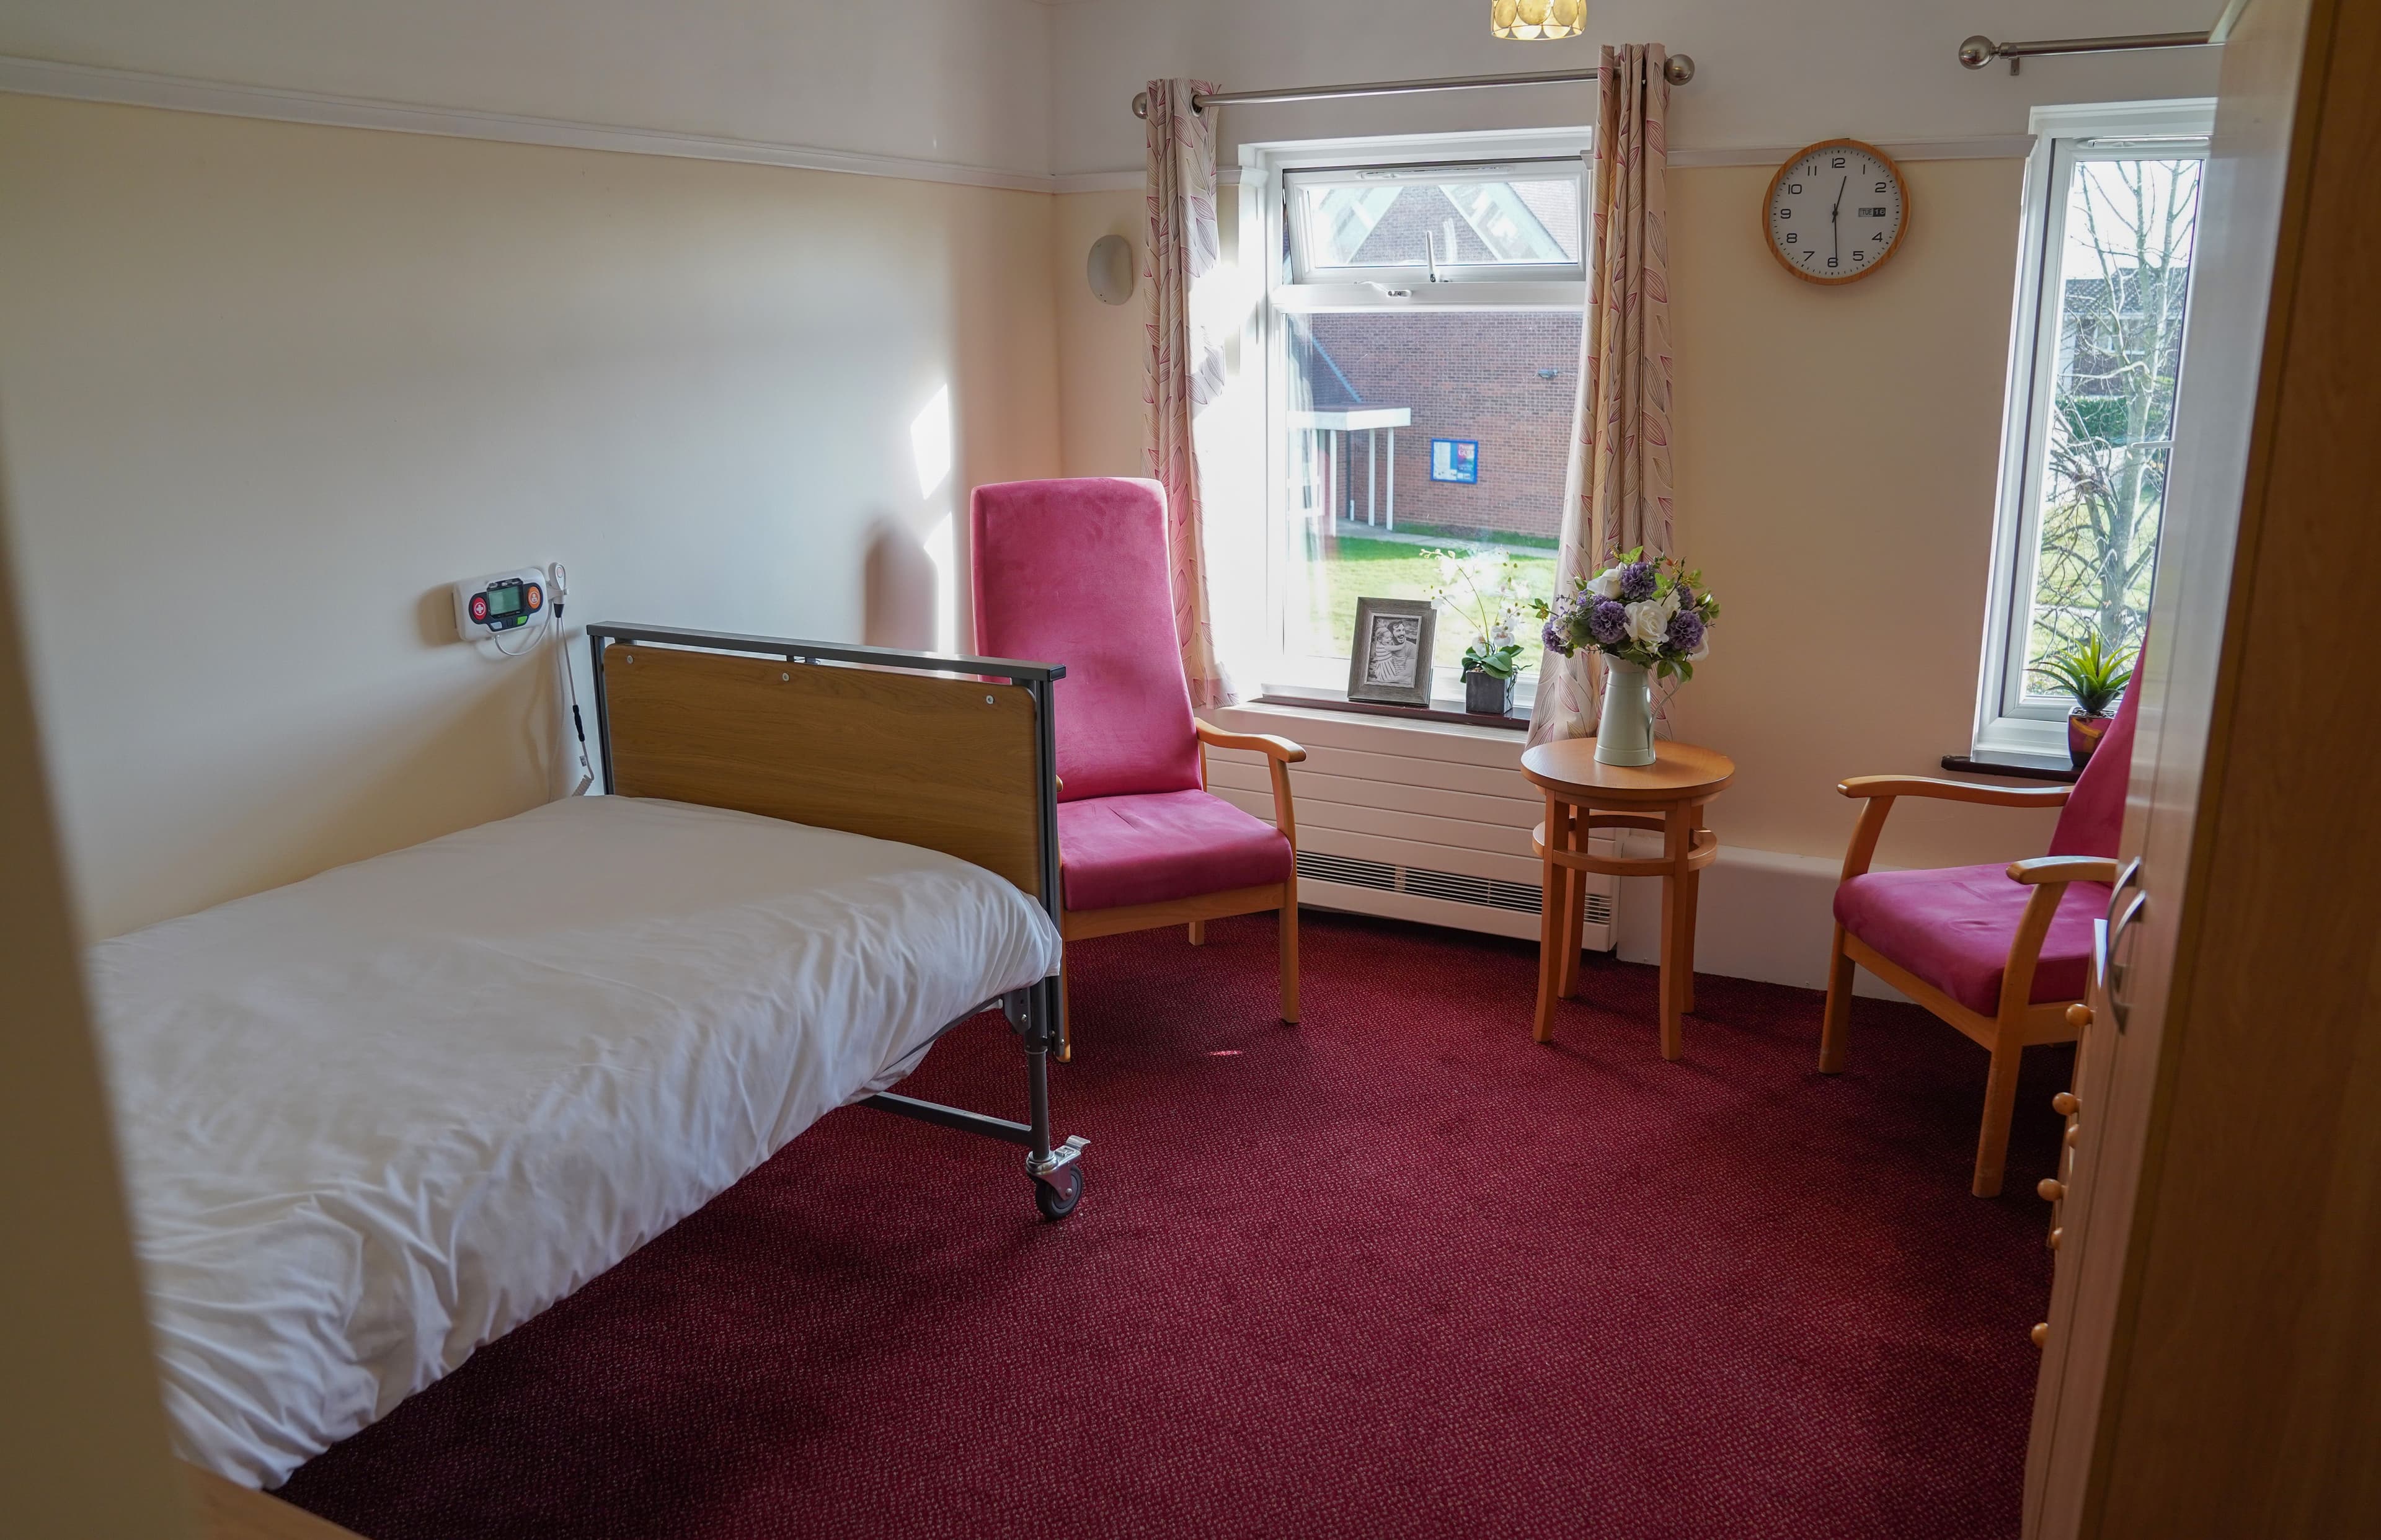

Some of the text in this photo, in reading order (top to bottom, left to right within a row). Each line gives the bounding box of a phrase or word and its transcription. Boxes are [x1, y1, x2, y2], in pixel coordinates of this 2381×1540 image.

[1832, 157, 1845, 168] 12
[1807, 166, 1817, 176] 11
[1863, 164, 1865, 174] 1
[1788, 184, 1802, 194] 10
[1874, 182, 1887, 193] 2
[1780, 208, 1791, 219] 9
[1786, 232, 1798, 243] 8
[1871, 232, 1883, 242] 4
[1803, 251, 1815, 261] 7
[1853, 250, 1864, 261] 5
